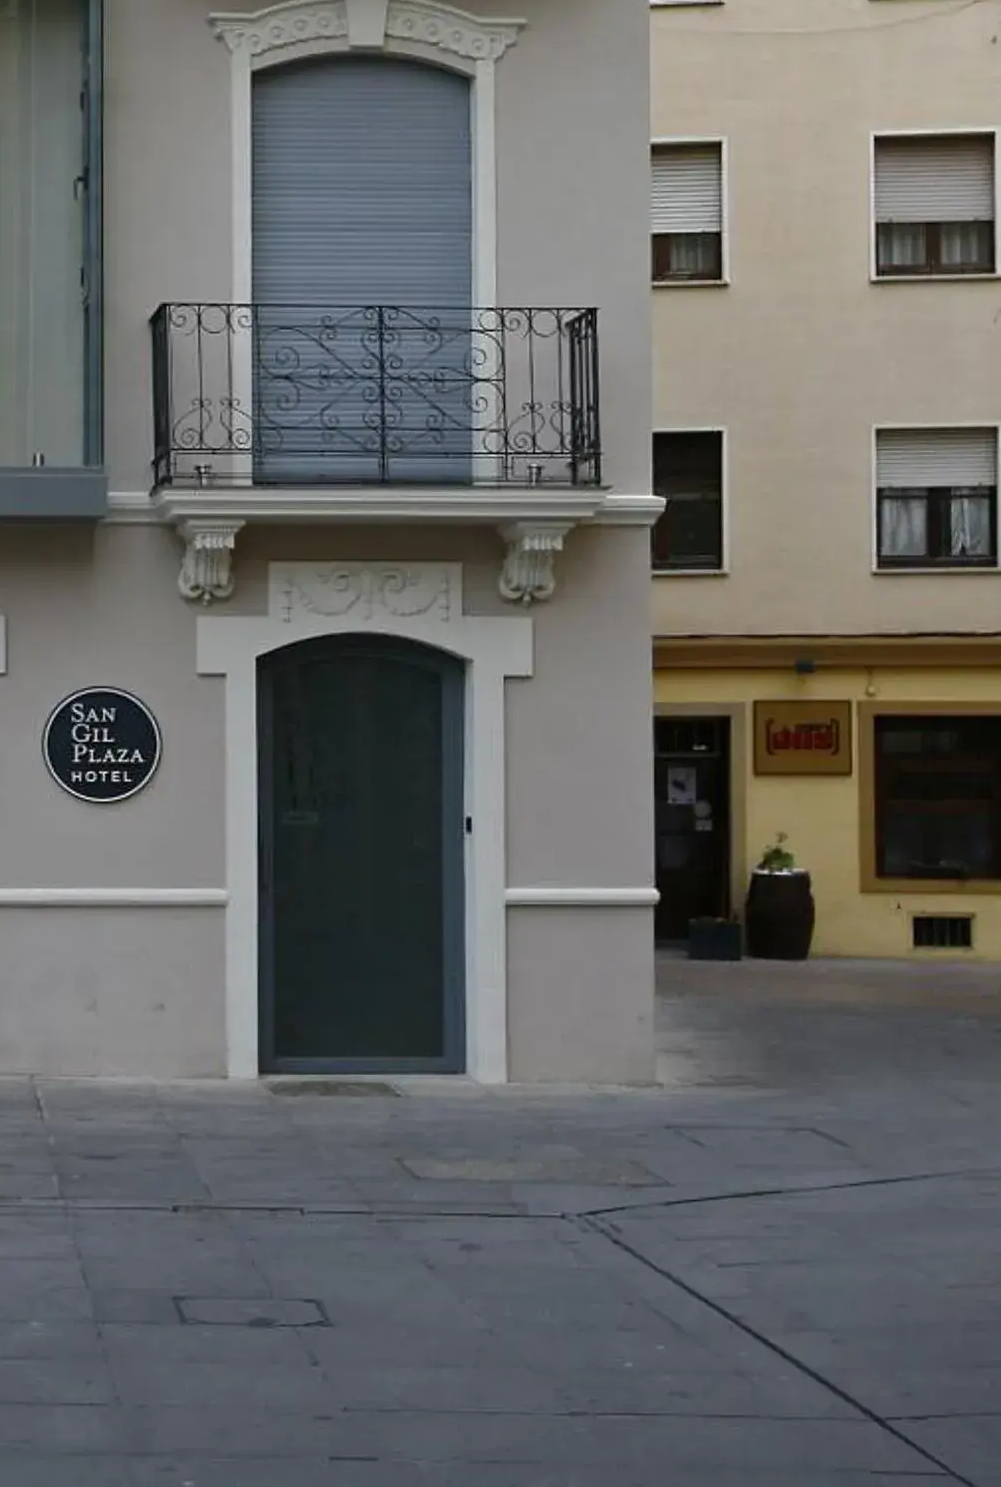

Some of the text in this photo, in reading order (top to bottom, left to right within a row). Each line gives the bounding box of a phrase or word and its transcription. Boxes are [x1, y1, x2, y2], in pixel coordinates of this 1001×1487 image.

[71, 703, 117, 723] SAN
[71, 723, 115, 743] GIL
[71, 743, 144, 763] PLAZA
[71, 771, 133, 782] HOTEL
